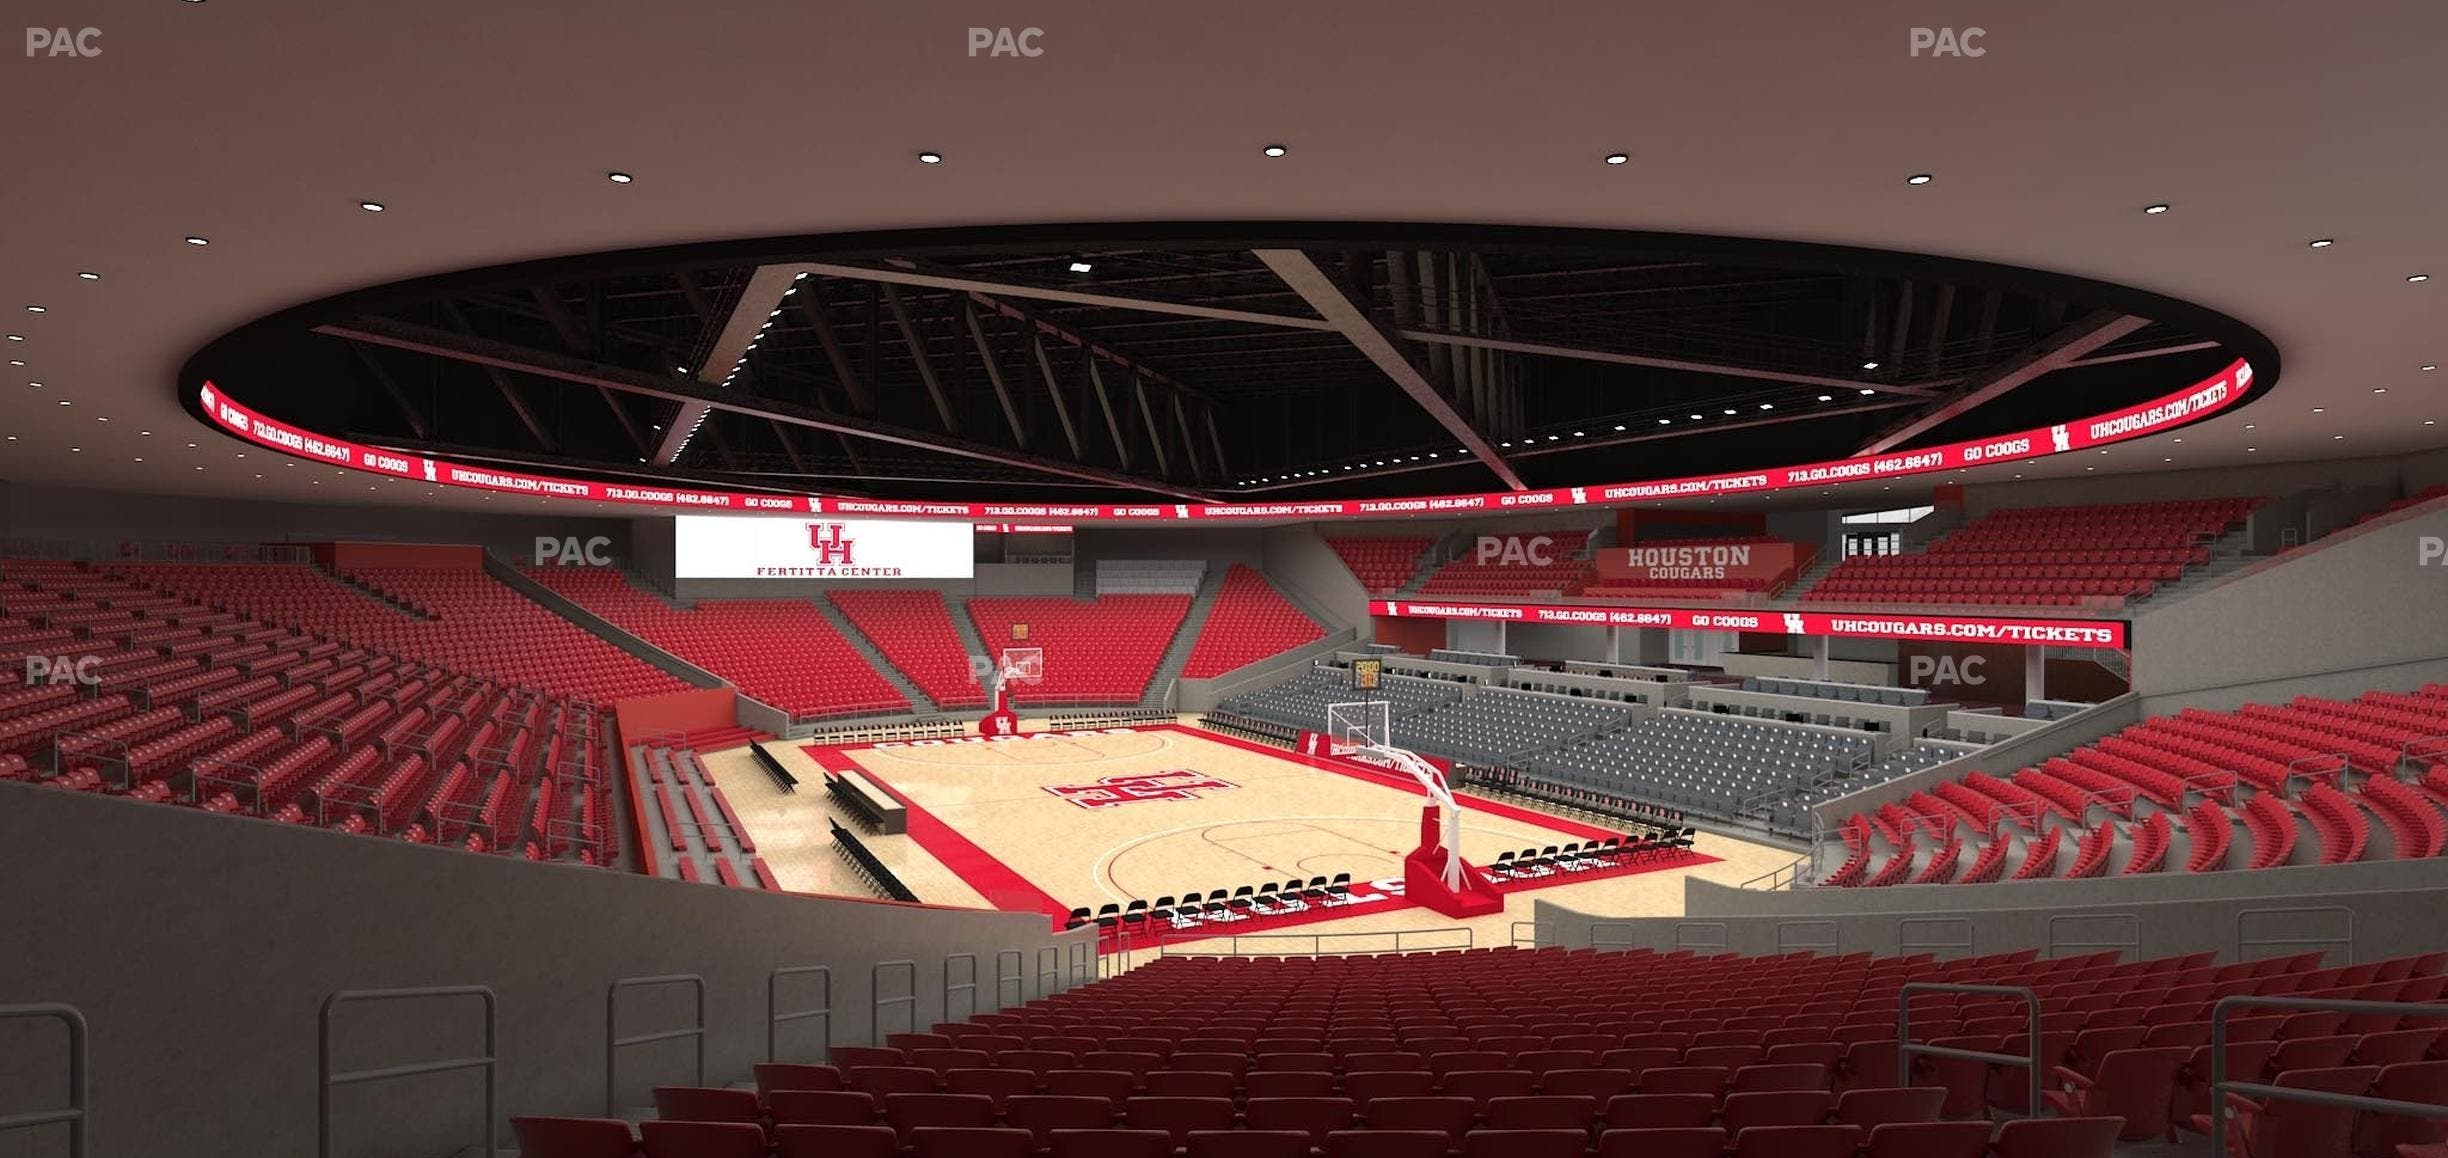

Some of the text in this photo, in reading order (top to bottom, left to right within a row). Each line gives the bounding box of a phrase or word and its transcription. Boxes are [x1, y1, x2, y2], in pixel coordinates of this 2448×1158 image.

[2090, 380, 2227, 440] UHCOUGARS.COM/TICKETS
[1963, 439, 2030, 461] GO COOGS
[452, 469, 588, 495] UHCOUGARS.COM/TICKETS
[1605, 475, 1767, 498] UHCOUGARS.COM/TICKETS
[1628, 546, 1750, 567] HOUSTON
[757, 567, 902, 576] FERTITTA CENTER
[1649, 567, 1725, 579] COUGARS
[1692, 615, 1759, 628] GO COOGS
[1831, 619, 2112, 642] UHCOUGARS.COM/TICKETS
